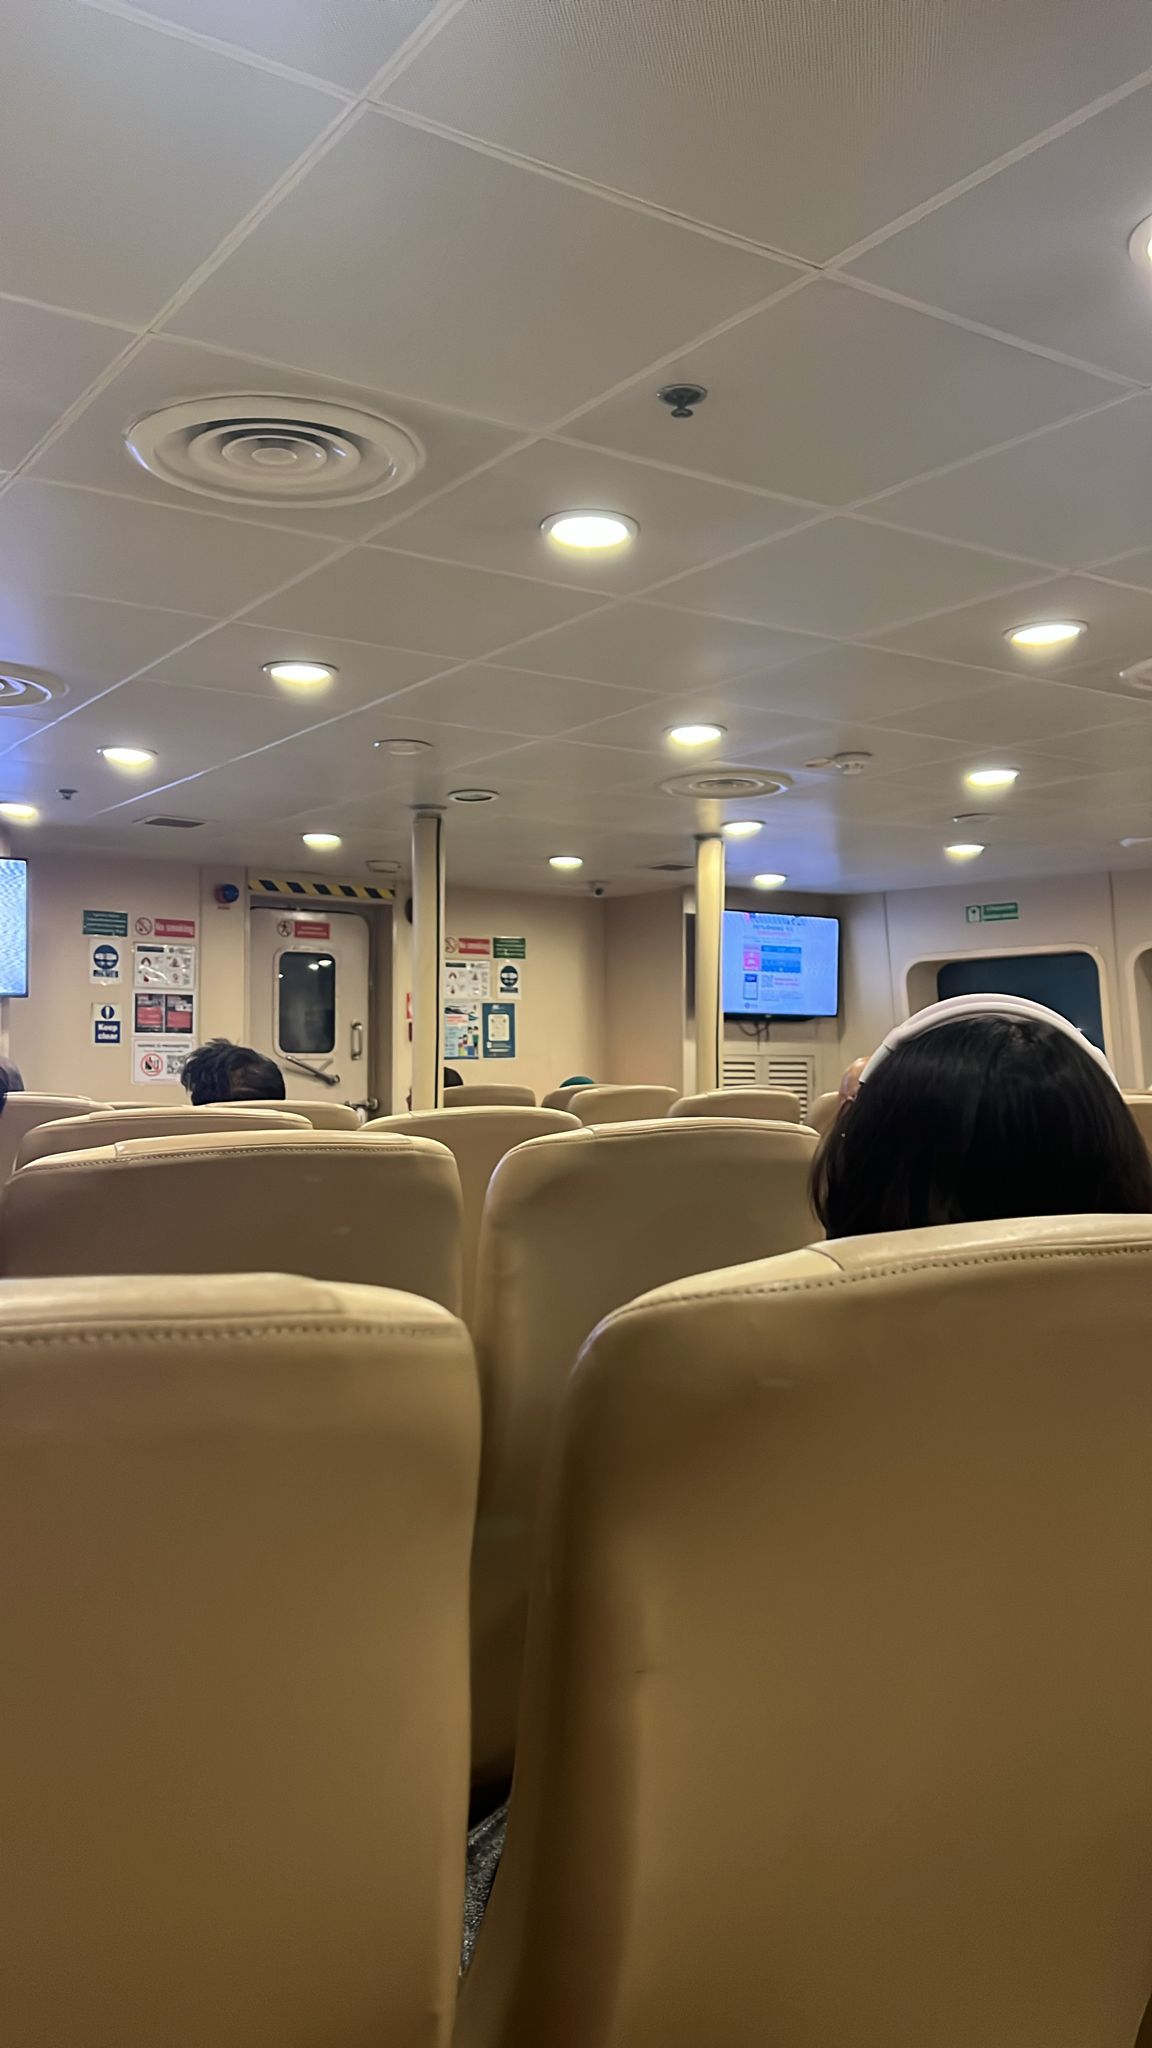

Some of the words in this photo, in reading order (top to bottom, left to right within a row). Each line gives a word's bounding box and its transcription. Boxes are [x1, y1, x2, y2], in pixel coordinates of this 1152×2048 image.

[155, 921, 165, 931] No
[166, 924, 195, 935] smoking
[97, 1023, 118, 1032] Keep
[97, 1032, 118, 1040] clear
